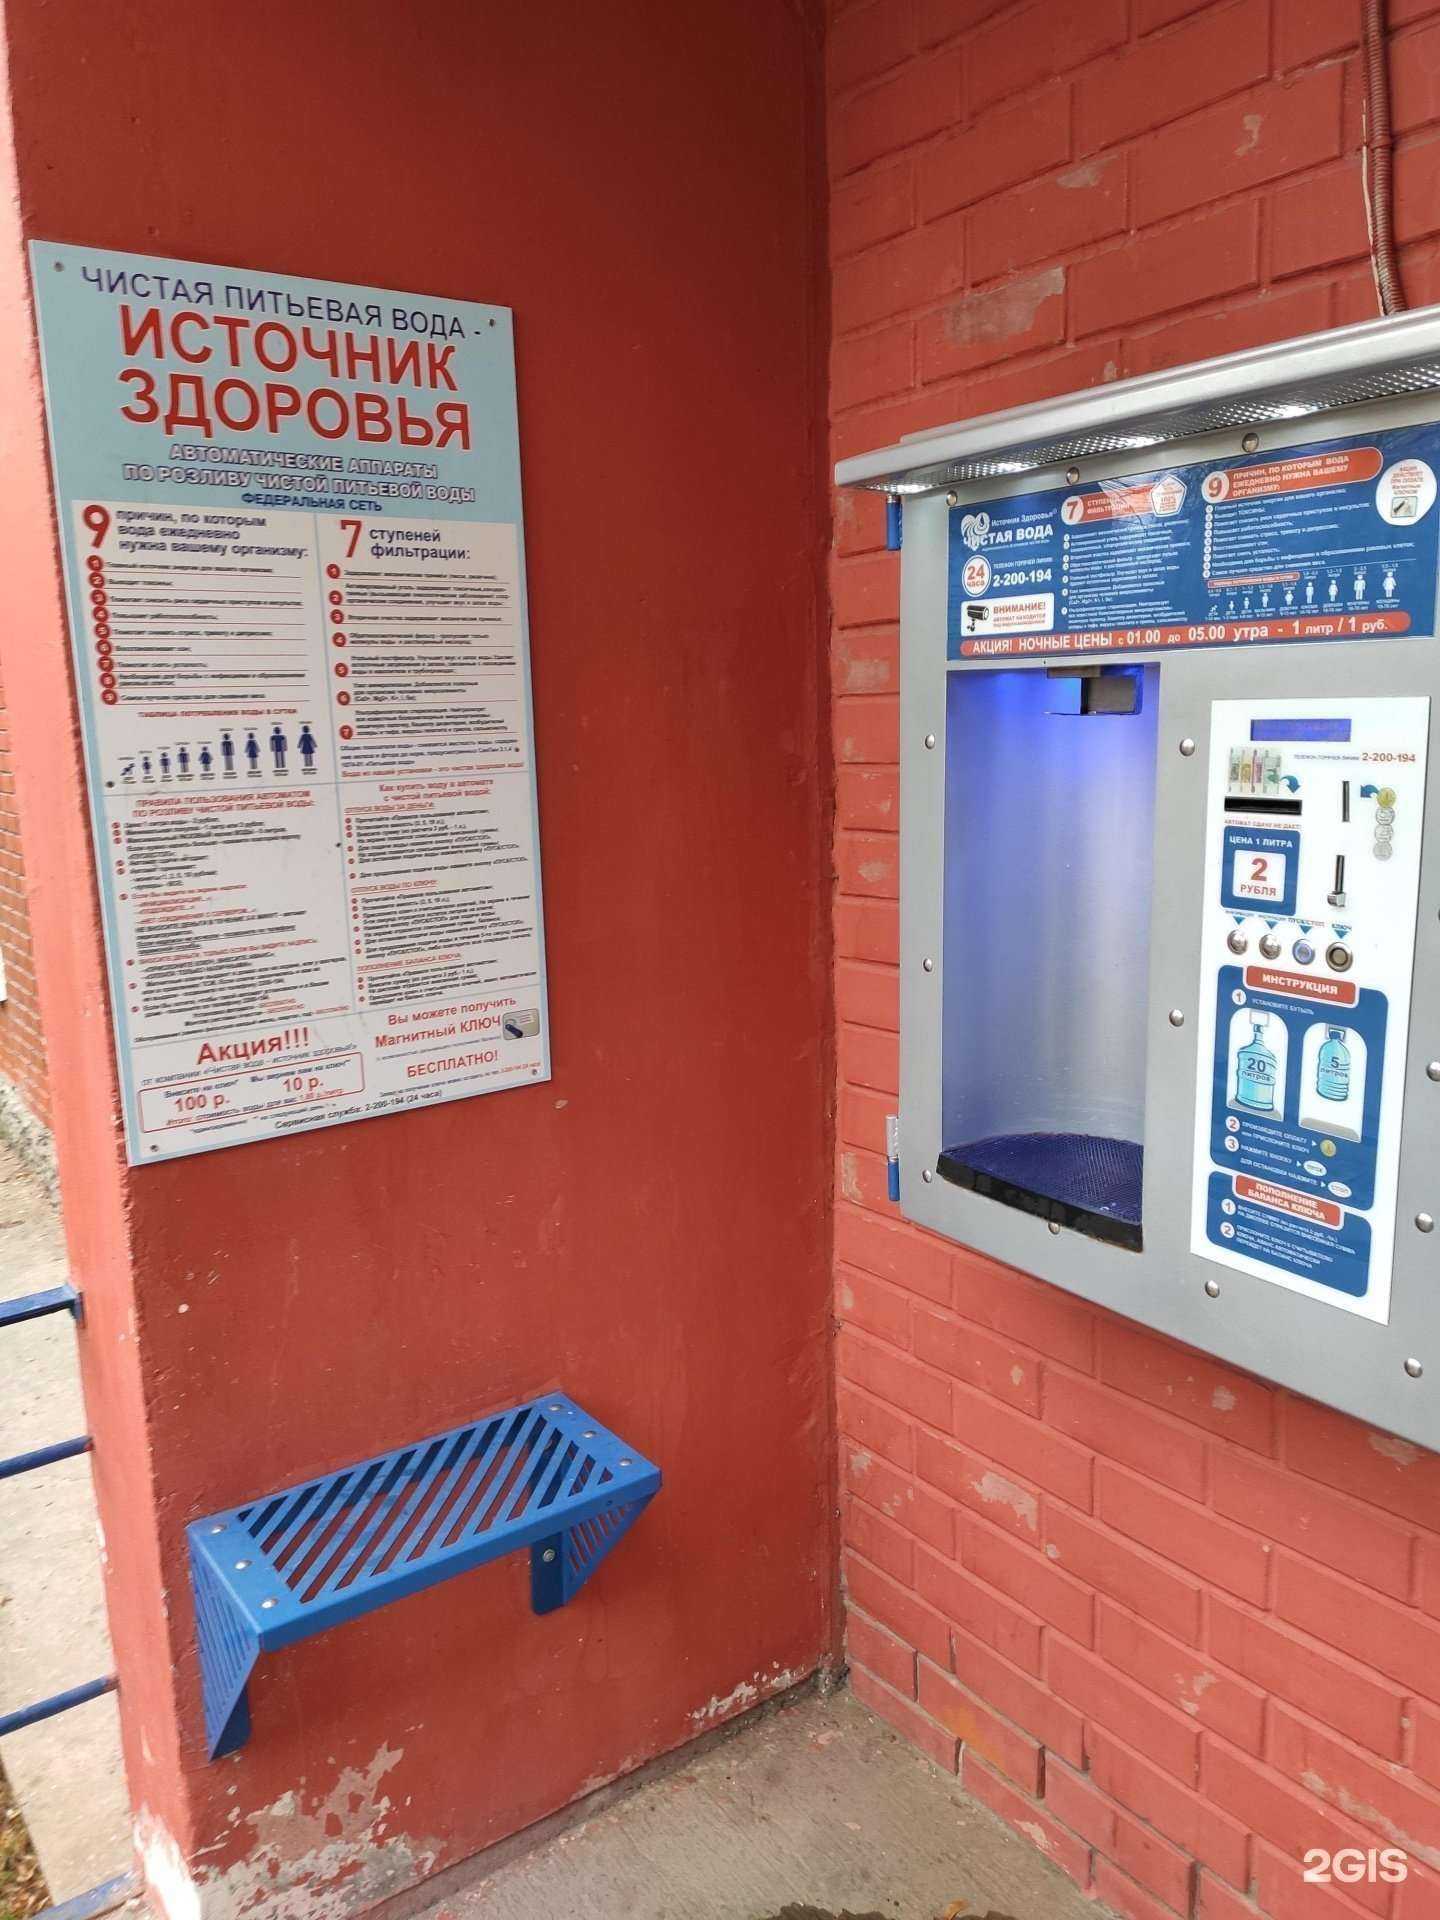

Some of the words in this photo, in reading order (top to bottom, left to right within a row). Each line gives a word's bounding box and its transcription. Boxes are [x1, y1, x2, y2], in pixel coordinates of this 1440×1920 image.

[81, 266, 213, 306] ЧИСТАЯ
[225, 286, 381, 327] ПИТЬЕВАЯ
[393, 308, 464, 340] ВОДА
[119, 304, 459, 391] ИСТОЧНИК
[118, 367, 472, 451] ЗДОРОВЬЯ
[170, 444, 343, 472] АВТОМАТИЧЕСКИЕ
[348, 458, 438, 479] АППАРАТЫ
[1326, 455, 1349, 465] ВОДА
[123, 463, 154, 481] ПО
[159, 466, 251, 488] РОЗЛИВУ
[256, 471, 328, 492] ЧИСТОЙ
[332, 476, 423, 499] ПИТЬЕВОЙ
[427, 484, 475, 503] ВОДЫ
[1208, 477, 1223, 497] 9
[241, 492, 345, 511] ФЕДЕРАЛЬНАЯ
[348, 498, 382, 512] СЕТЬ
[1067, 501, 1078, 519] 7
[83, 504, 111, 549] 9
[116, 509, 178, 524] причин,
[181, 512, 200, 523] по
[204, 515, 266, 527] которым
[117, 525, 153, 537] вода
[159, 527, 240, 540] ежедневно
[340, 520, 362, 558] 7
[369, 528, 441, 543] ступеней
[1016, 524, 1054, 541] ВОДА
[119, 541, 166, 553] нужна
[171, 542, 233, 556] вашему
[232, 545, 308, 559] организму:
[371, 544, 471, 560] фильтрации:
[967, 565, 985, 580] 24
[993, 569, 1052, 587] 2-200-194
[993, 601, 1046, 614] ВНИМАНИЕ!
[972, 638, 1013, 656] АКЦИЯ!
[1018, 633, 1070, 651] НОЧНЫЕ
[1074, 630, 1113, 650] ЦЕНЫ
[1126, 629, 1161, 645] 01.00
[1167, 633, 1181, 644] до
[1188, 625, 1226, 641] 05.00
[1233, 625, 1269, 642] утра
[1292, 620, 1300, 634] 1
[1305, 623, 1334, 637] литр
[1348, 617, 1356, 631] 1
[1362, 620, 1388, 633] руб.
[1361, 752, 1416, 763] 2-200-194
[1229, 836, 1253, 845] ЦЕНА
[1263, 838, 1293, 848] ЛИТРА
[1250, 857, 1268, 882] 2
[1240, 883, 1277, 897] РУБЛЯ
[1262, 973, 1338, 995] ИНСТРУКЦИЯ
[388, 1014, 409, 1025] Вы
[412, 1007, 457, 1021] можете
[461, 997, 517, 1013] получить
[375, 1023, 456, 1048] Магнитный
[460, 1015, 500, 1033] КЛЮЧ
[195, 1027, 310, 1065] Акция!!!
[406, 1049, 498, 1078] БЕСПЛАТНО!
[1247, 1057, 1266, 1072] 20
[1330, 1056, 1340, 1068] 5
[282, 1077, 302, 1093] 10
[174, 1094, 207, 1113] 100
[1248, 1189, 1290, 1210] БАЛАНСА
[1290, 1202, 1327, 1221] КЛЮЧА
[1255, 1182, 1318, 1209] ПОПОЛНЕНИЕ
